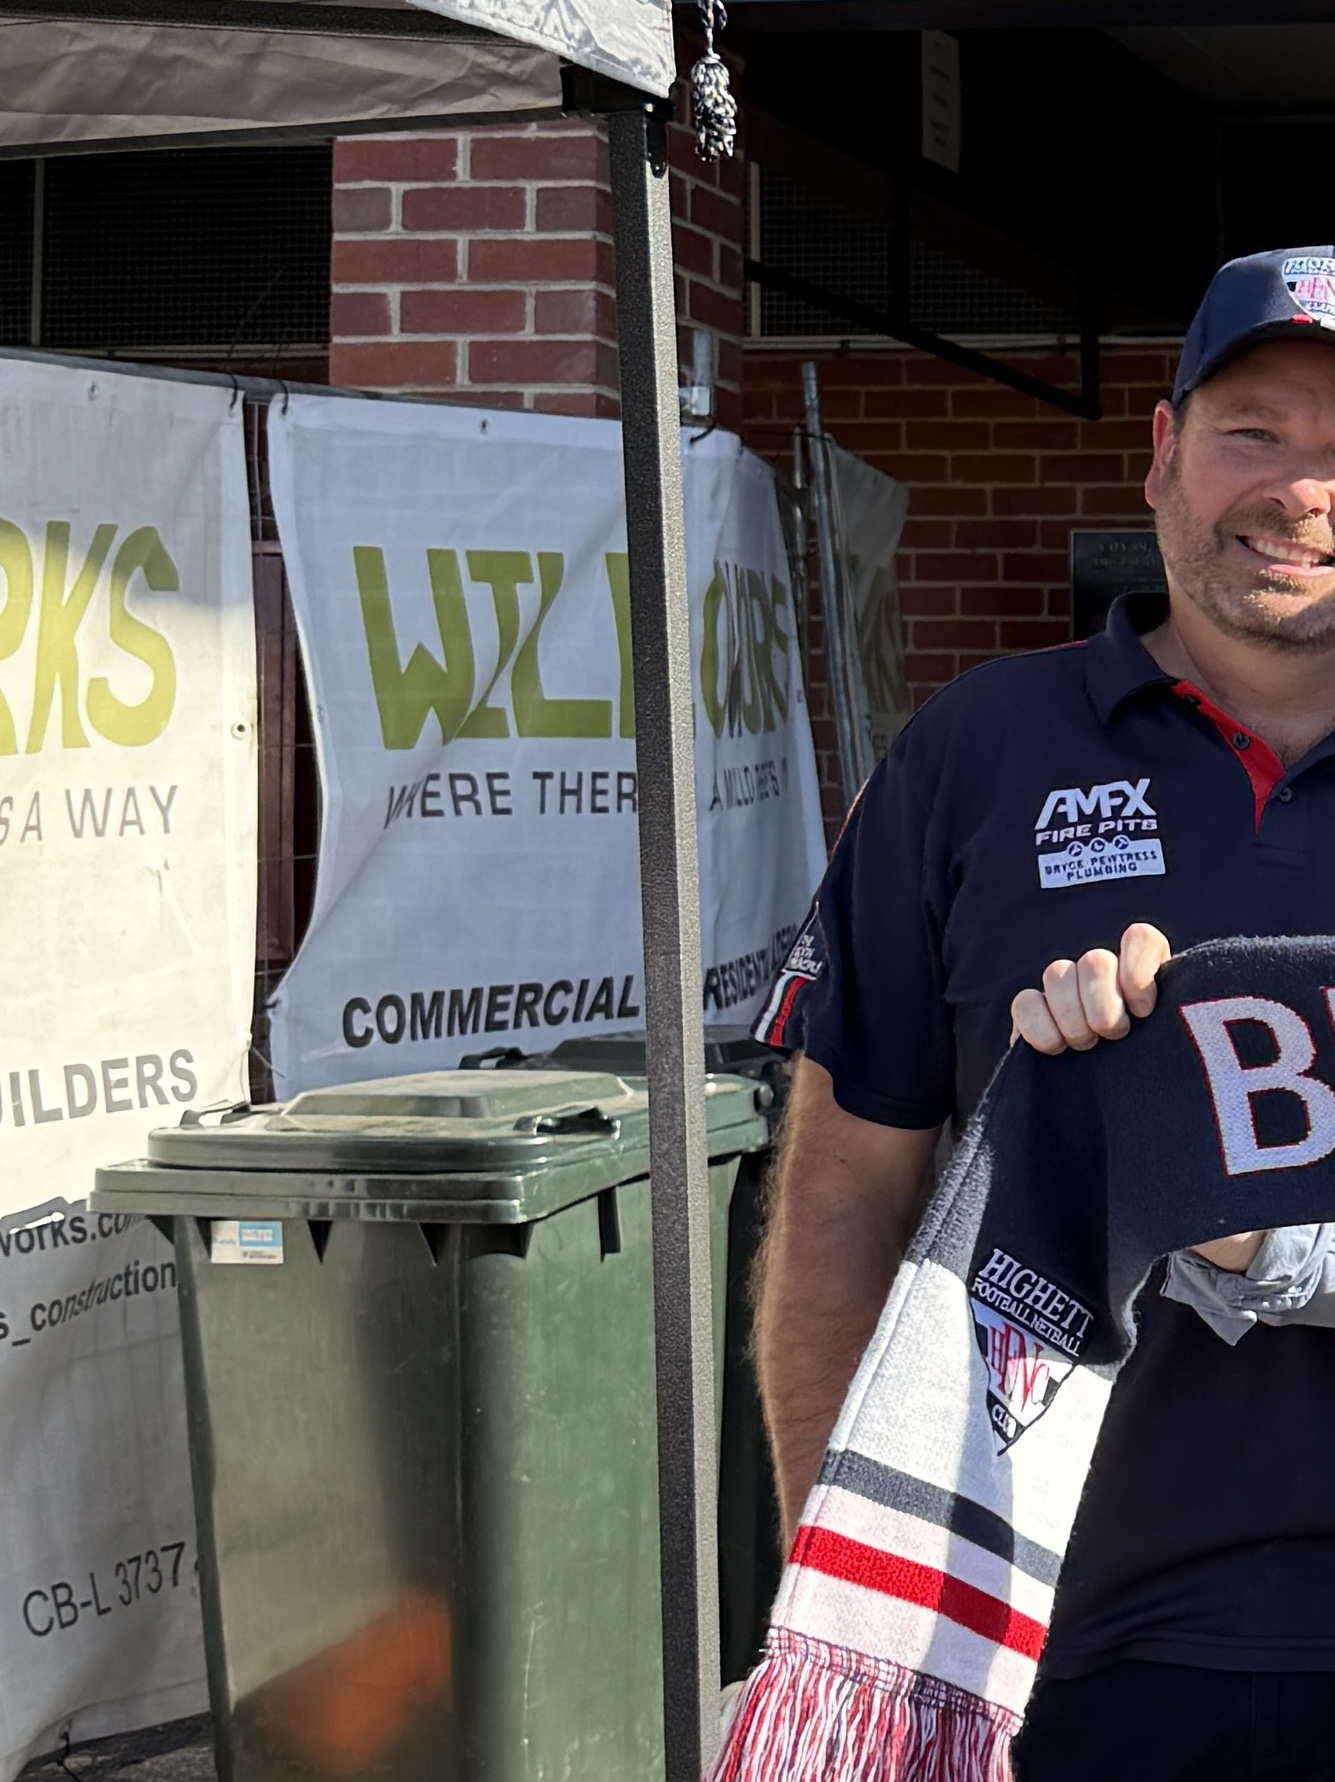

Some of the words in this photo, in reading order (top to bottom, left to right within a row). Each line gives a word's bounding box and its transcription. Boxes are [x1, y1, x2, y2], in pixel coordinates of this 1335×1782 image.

[20, 791, 43, 843] A
[65, 785, 178, 838] WAY
[1035, 823, 1092, 846] FIRE
[1098, 819, 1158, 834] PITS
[342, 974, 640, 1049] COMMERCIAL
[0, 1048, 198, 1128] ILDERS
[972, 1277, 1034, 1328] FOOTBALL
[1031, 1313, 1080, 1358] NETBALL
[977, 1247, 1095, 1338] HIGHETT
[23, 1572, 112, 1637] CB-L
[115, 1541, 198, 1607] 3737
